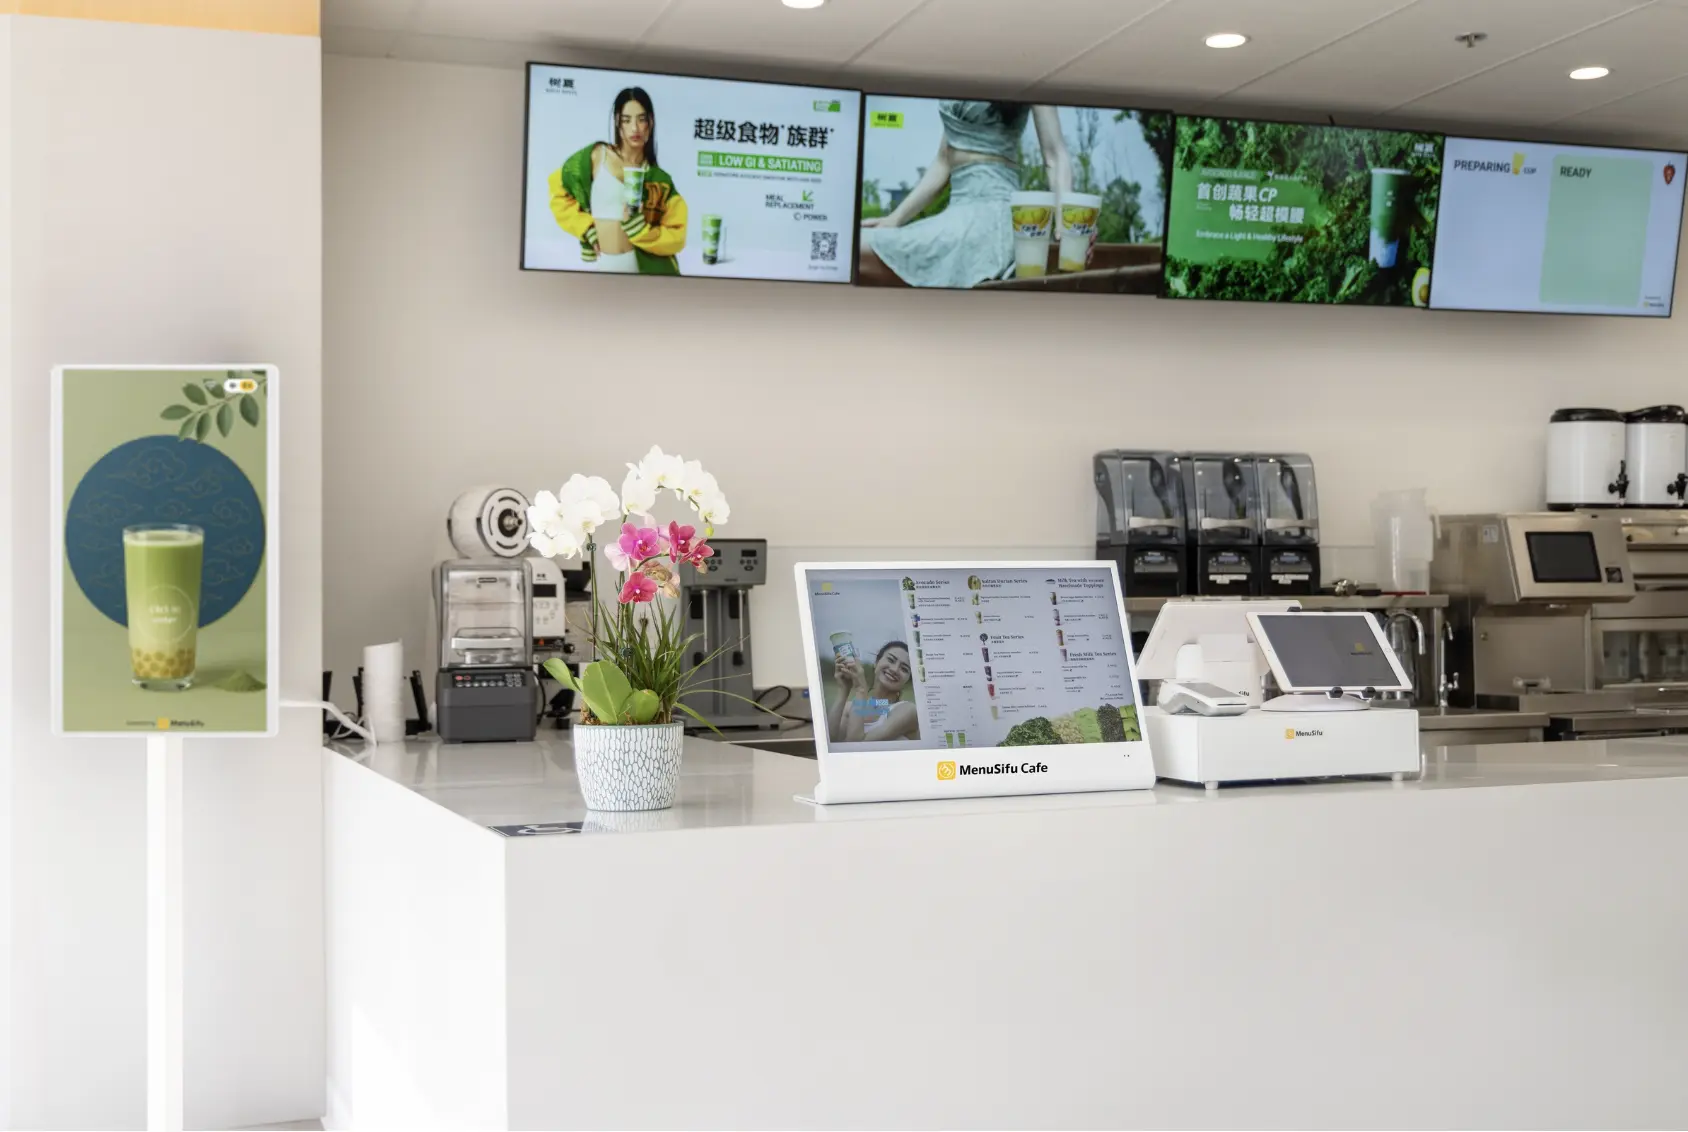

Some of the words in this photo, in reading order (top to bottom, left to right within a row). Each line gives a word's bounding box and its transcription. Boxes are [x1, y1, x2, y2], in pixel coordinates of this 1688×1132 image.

[719, 154, 743, 167] LOW
[746, 156, 757, 168] GI
[758, 157, 765, 169] &
[768, 158, 822, 173] SATIATING
[1454, 159, 1511, 174] PREPARING
[1559, 166, 1592, 178] READY
[765, 193, 784, 201] MEAL
[765, 201, 814, 211] REPLACEMENT
[959, 763, 1018, 775] MenuSifu
[1020, 762, 1048, 774] Cafe
